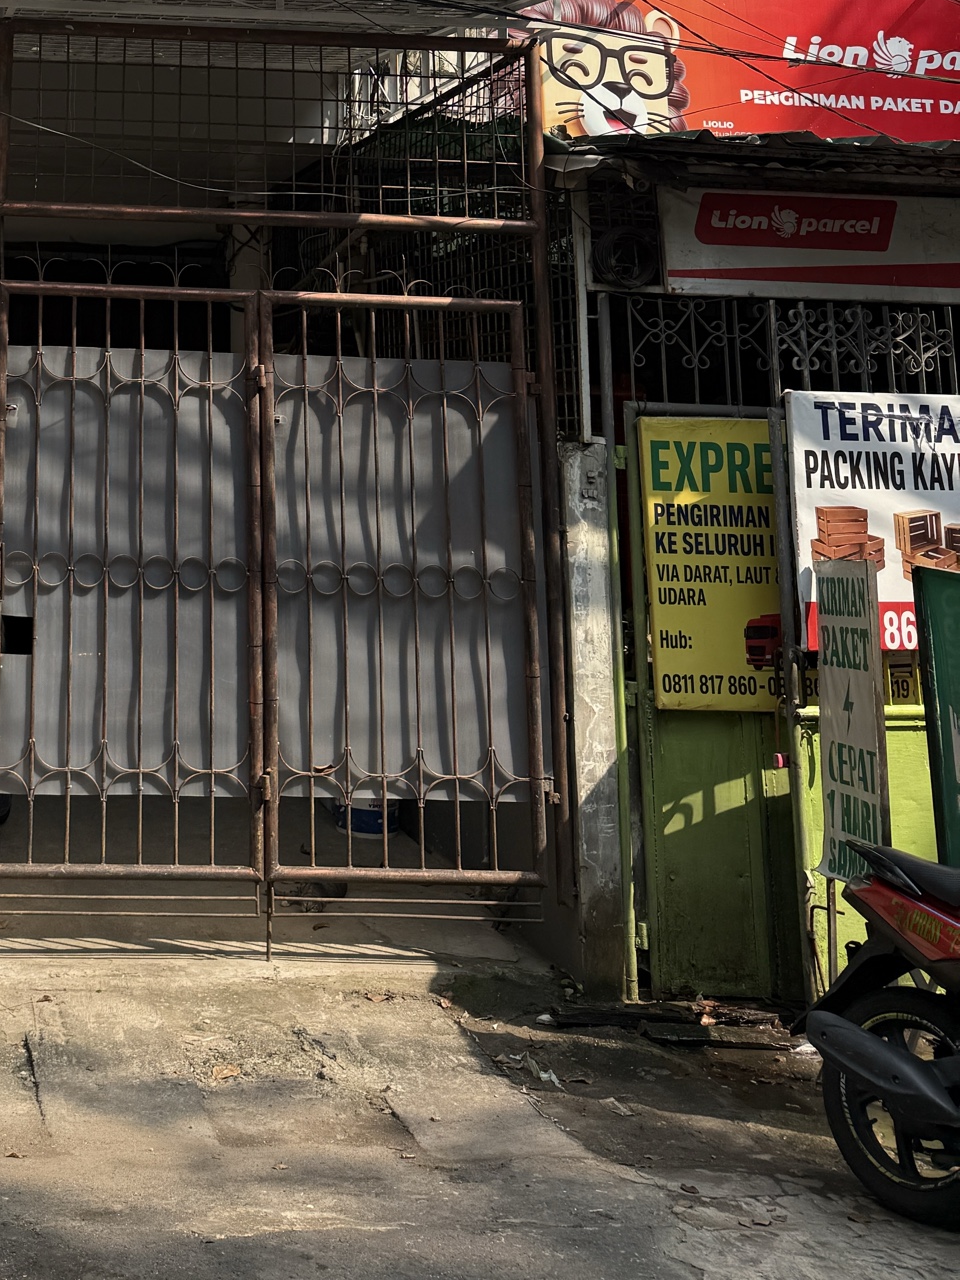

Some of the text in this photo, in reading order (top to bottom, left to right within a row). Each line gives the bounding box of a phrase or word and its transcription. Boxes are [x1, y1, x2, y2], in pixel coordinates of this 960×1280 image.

[783, 35, 869, 67] Lion
[740, 89, 960, 115] PENGIRIMAN PAKET DA
[703, 120, 734, 129] LIOLIO
[711, 209, 881, 236] Lion parcel
[814, 401, 960, 444] TERIMA
[650, 440, 774, 494] EXPRE
[804, 449, 960, 491] PACKING KAY
[653, 503, 770, 528] PENGIRIMAN
[655, 532, 678, 554] KE
[682, 532, 765, 557] SELURUH
[656, 564, 680, 582] VIA
[684, 565, 733, 587] DARAT,
[736, 566, 771, 585] LAUT
[658, 587, 707, 606] UDARA
[817, 577, 867, 618] KIRIMAN
[660, 630, 692, 650] Hub:
[821, 625, 869, 672] PAKET
[662, 673, 695, 694] 0811
[700, 674, 724, 695] 817
[828, 740, 877, 795] CEPAT
[826, 789, 879, 846] 1 HARI
